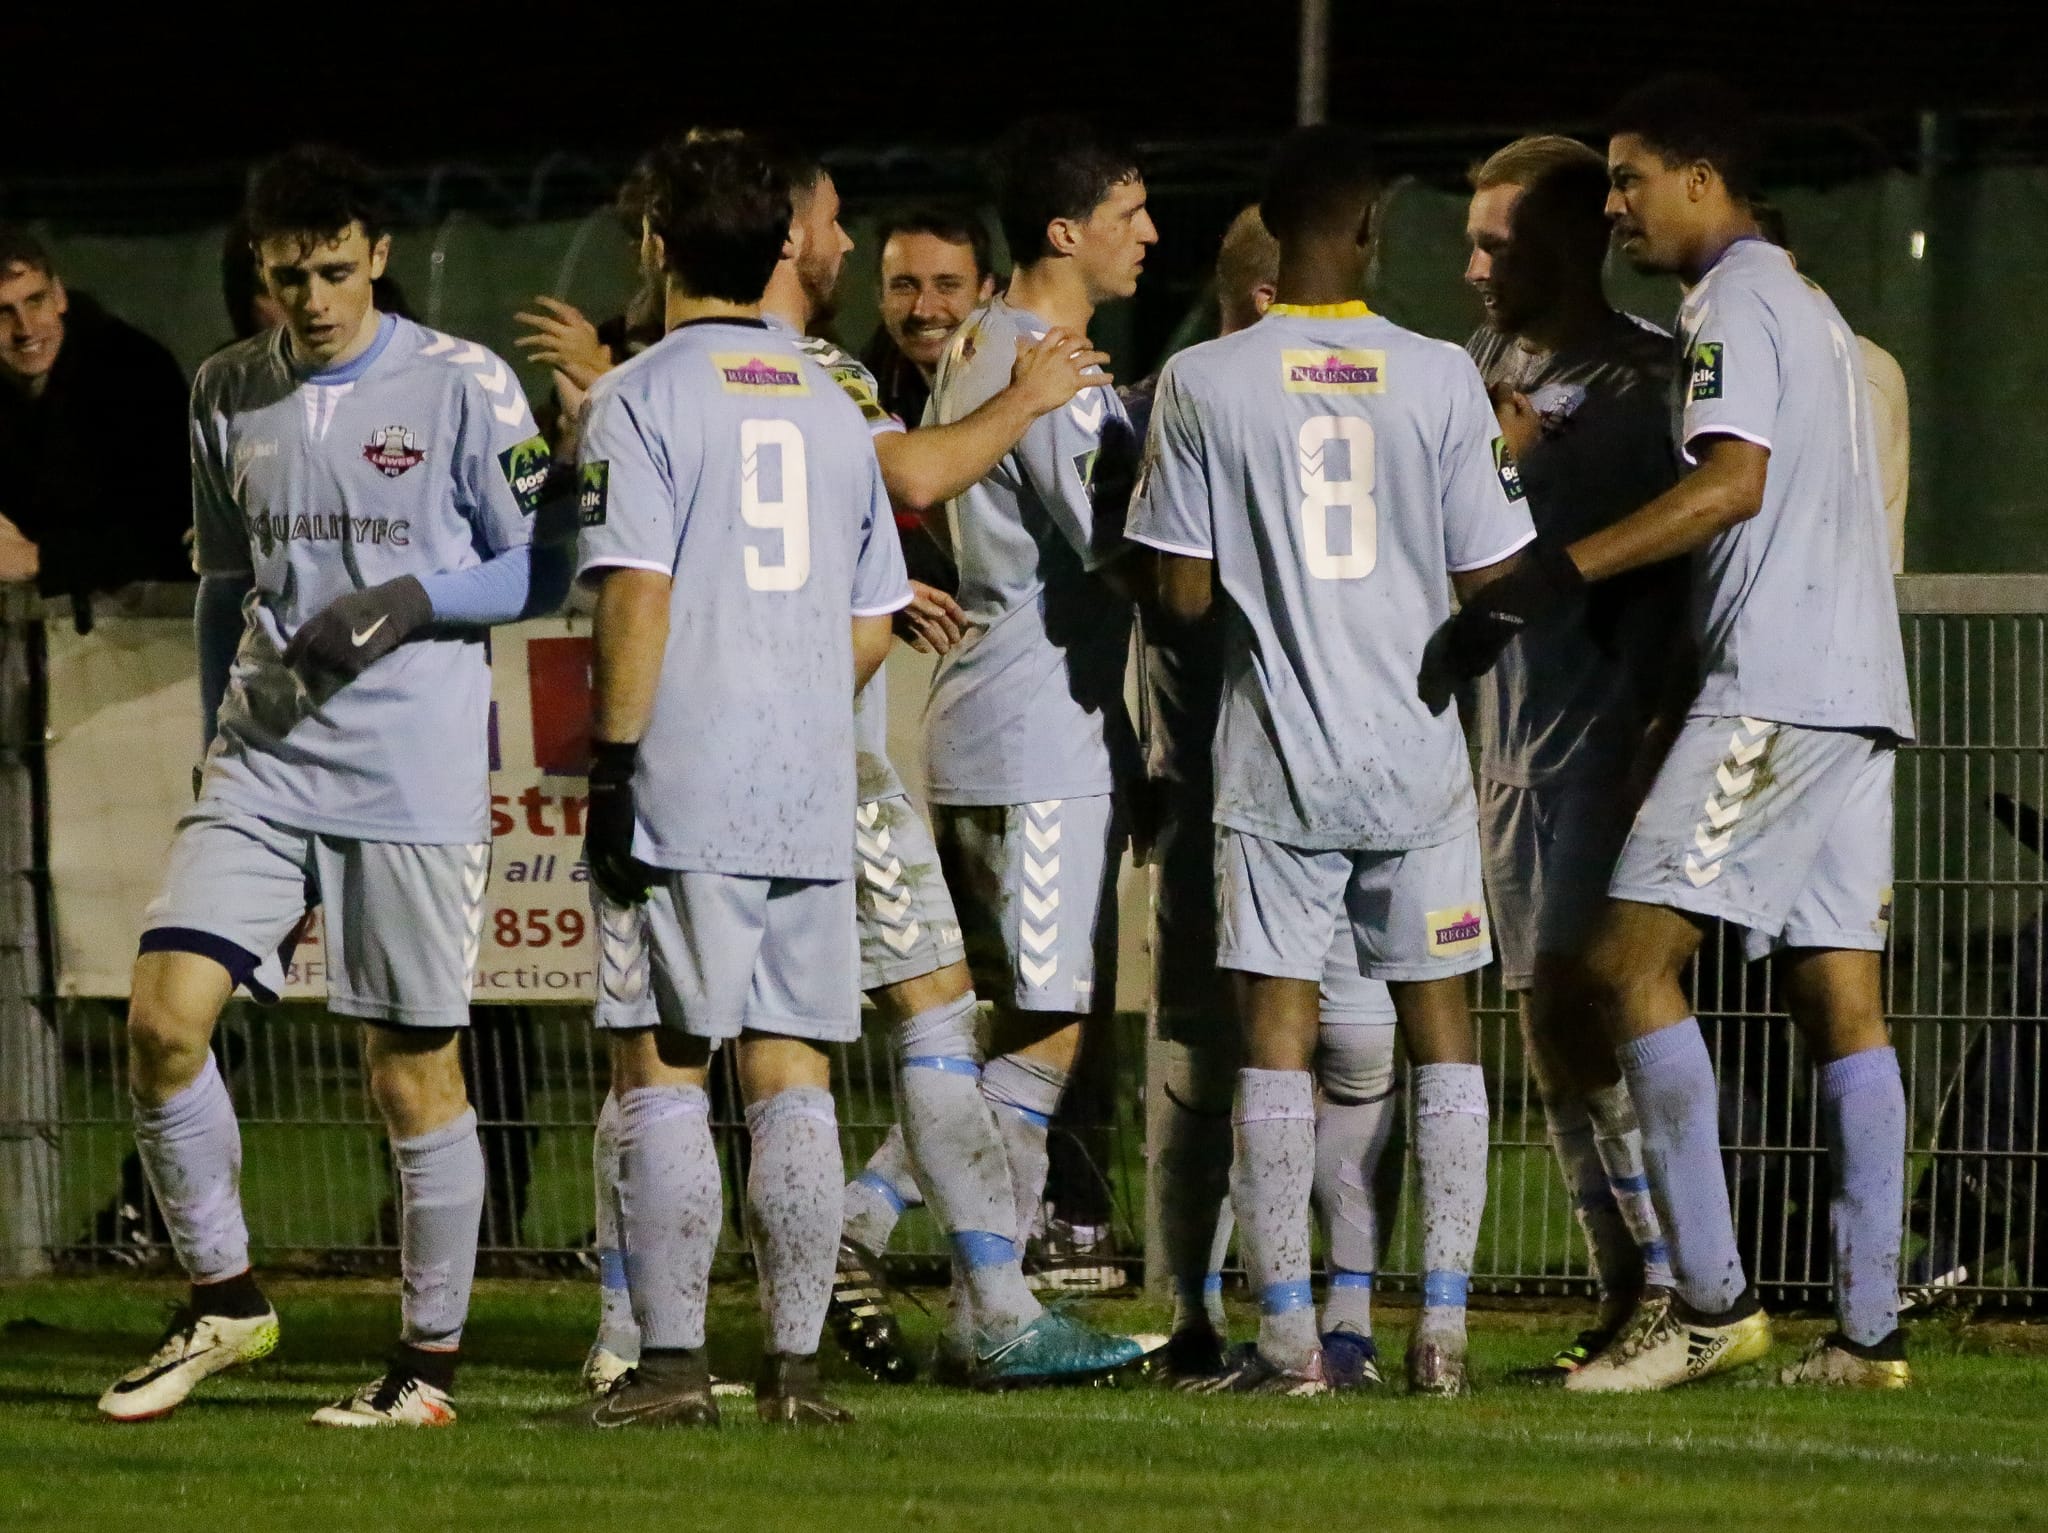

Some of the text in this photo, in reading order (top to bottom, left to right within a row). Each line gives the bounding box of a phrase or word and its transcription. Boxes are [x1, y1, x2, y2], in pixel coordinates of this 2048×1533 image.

[727, 368, 798, 385] REGENCY
[1293, 367, 1372, 382] REGENCY
[1694, 369, 1716, 382] tik
[581, 491, 600, 507] tik
[741, 419, 810, 591] 9
[1299, 416, 1377, 580] 8
[505, 854, 590, 883] all a
[1440, 924, 1479, 943] REGEN
[1687, 1335, 1729, 1377] adidas
